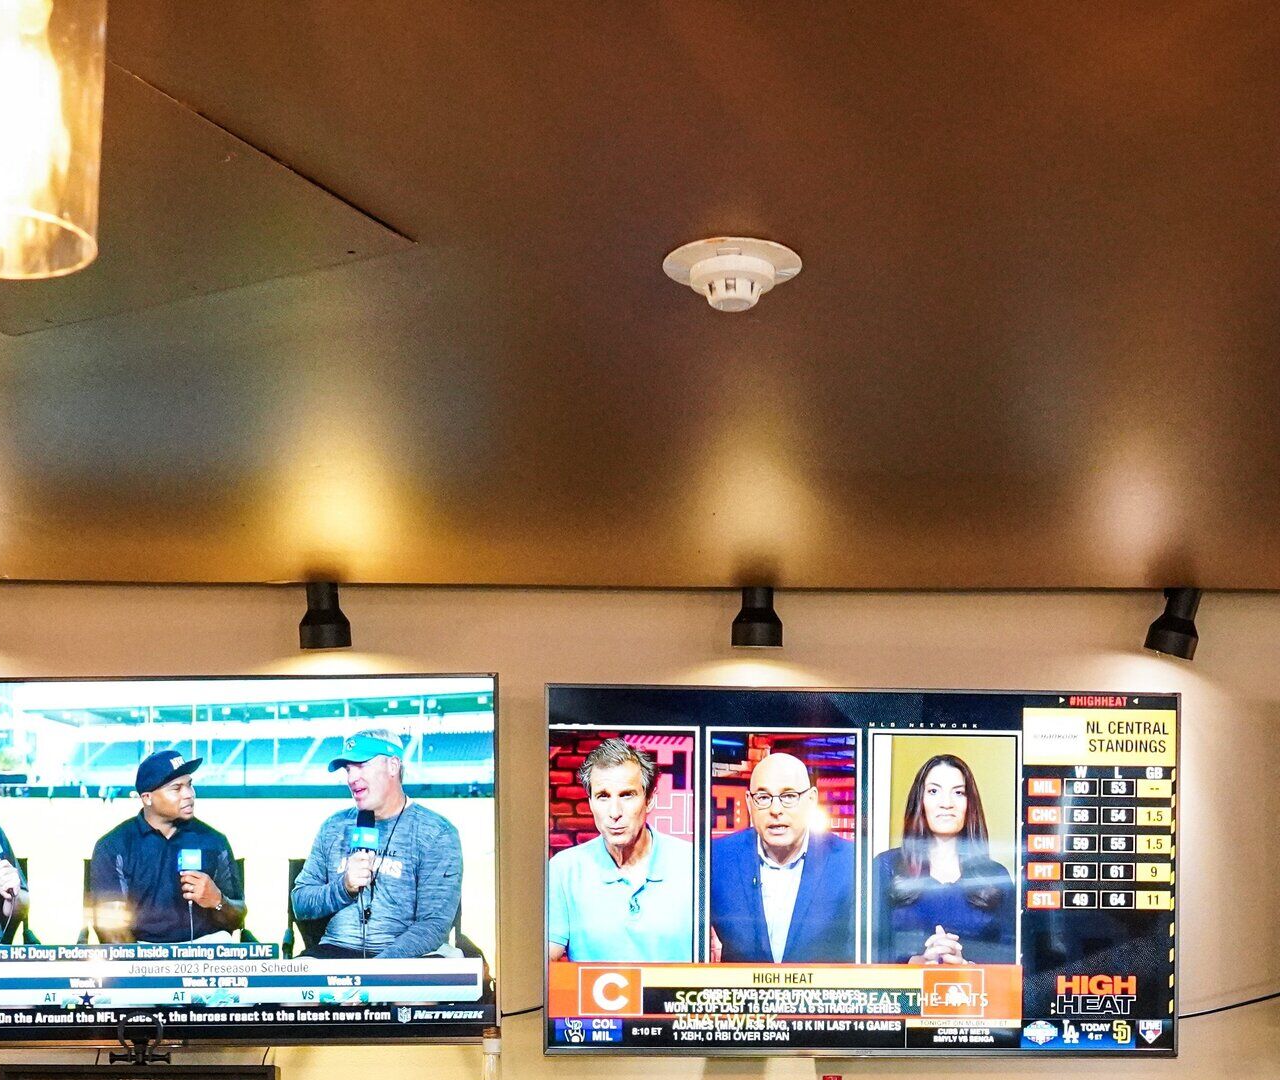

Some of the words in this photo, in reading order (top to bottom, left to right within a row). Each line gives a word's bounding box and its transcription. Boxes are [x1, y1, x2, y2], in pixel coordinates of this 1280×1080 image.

[1070, 696, 1128, 707] #HIGHHEAT
[1086, 721, 1103, 735] NL
[1108, 721, 1170, 736] CENTRAL
[1088, 739, 1167, 753] STANDINGS
[1074, 766, 1088, 778] W
[1114, 767, 1123, 779] L
[1033, 781, 1056, 793] MIL
[1033, 893, 1055, 906] STL
[10, 947, 27, 959] HC
[28, 946, 56, 960] Doug
[58, 946, 108, 959] Pederson
[109, 946, 135, 960] joins
[137, 946, 169, 958] Inside
[170, 946, 214, 960] Training
[216, 945, 248, 959] Camp
[250, 945, 273, 957] LIVE
[129, 964, 170, 976] Jaguars
[174, 963, 200, 973] 2023
[203, 962, 257, 973] Preseason
[261, 962, 309, 973] Schedule
[753, 972, 780, 985] HIGH
[784, 972, 813, 985] HEAT
[592, 972, 629, 1010] C
[1057, 975, 1137, 995] HIGH
[1057, 995, 1137, 1014] HEAT
[14, 1012, 32, 1023] the
[35, 1012, 73, 1023] Around
[76, 1012, 95, 1023] the
[97, 1012, 118, 1022] NFL
[413, 1010, 484, 1019] NETWORK
[592, 1020, 617, 1030] COL
[592, 1031, 613, 1041] MIL
[631, 1027, 649, 1036] 8:10
[650, 1027, 663, 1036] ET
